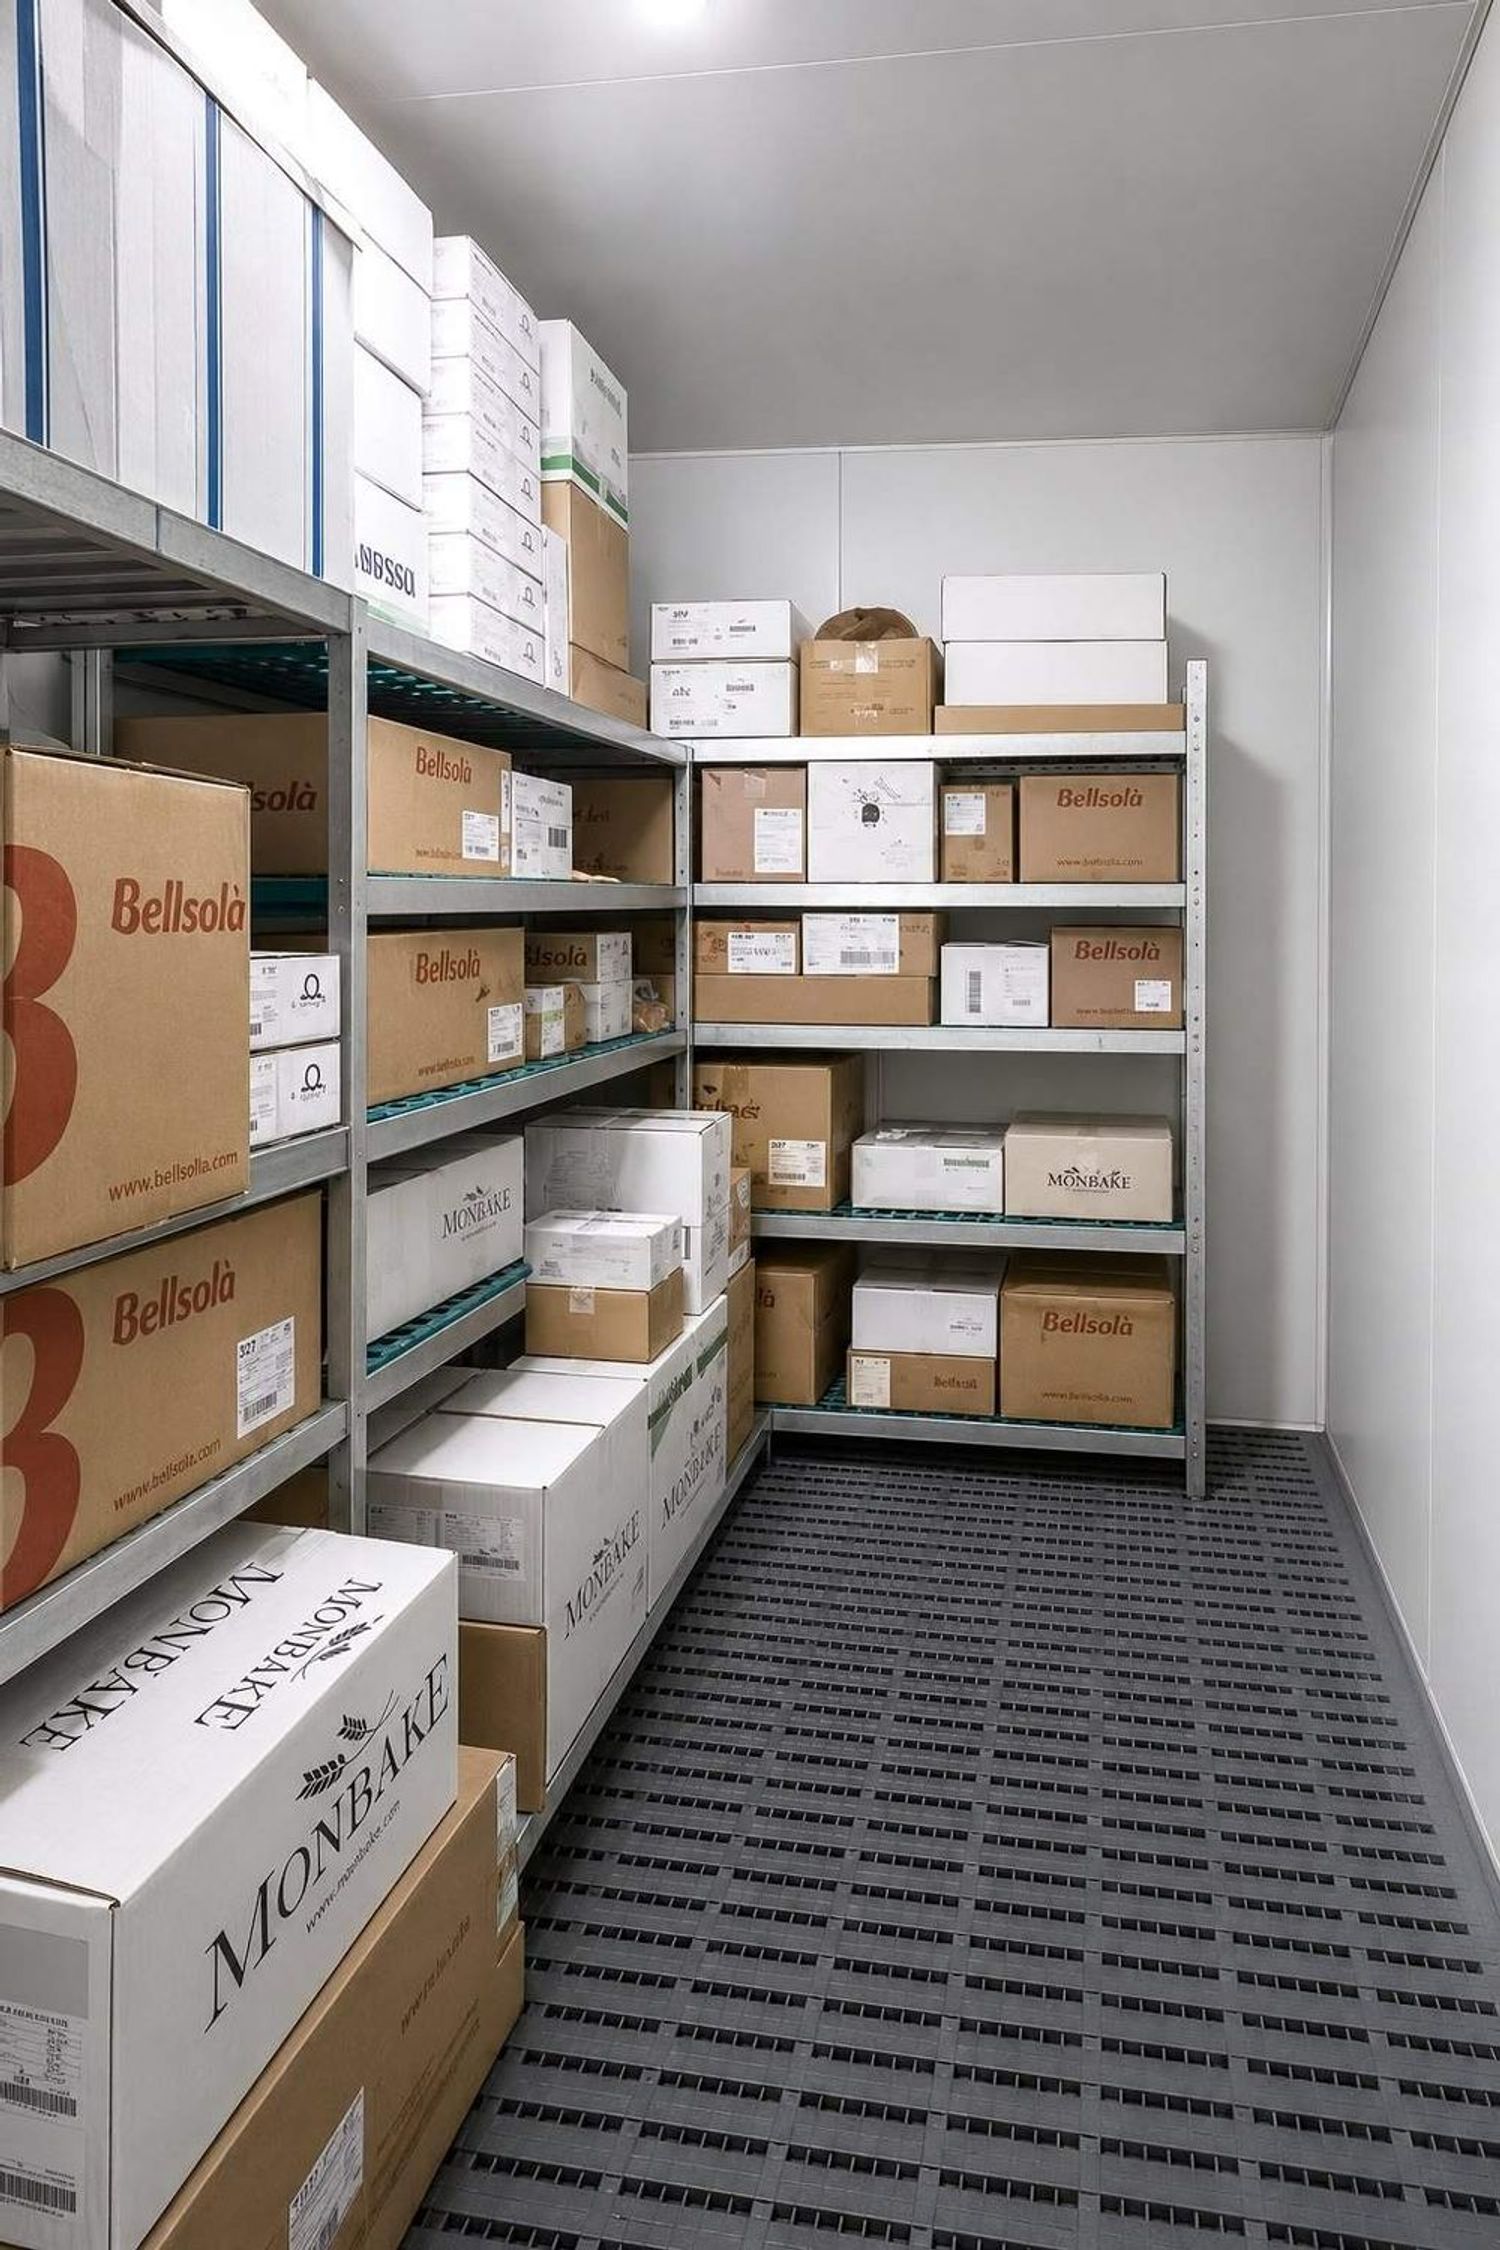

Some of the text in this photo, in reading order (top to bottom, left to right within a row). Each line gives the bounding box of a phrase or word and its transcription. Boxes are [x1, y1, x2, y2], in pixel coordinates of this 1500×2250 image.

[415, 746, 473, 784] Bellsolà
[1056, 787, 1143, 808] Bellsolà
[111, 877, 246, 935] Bellsolà
[416, 949, 481, 984] Bellsolà
[1075, 940, 1160, 960] Bellsolà
[1047, 1171, 1132, 1189] MONBAKE
[112, 1259, 236, 1346] Bellsolà
[1043, 1312, 1134, 1336] Bellsolà
[563, 1508, 641, 1641] MONBAKE
[18, 1561, 285, 1752] MONBAKE
[194, 1577, 384, 1731] MONBAKE
[204, 1652, 450, 2034] MONBAKE
